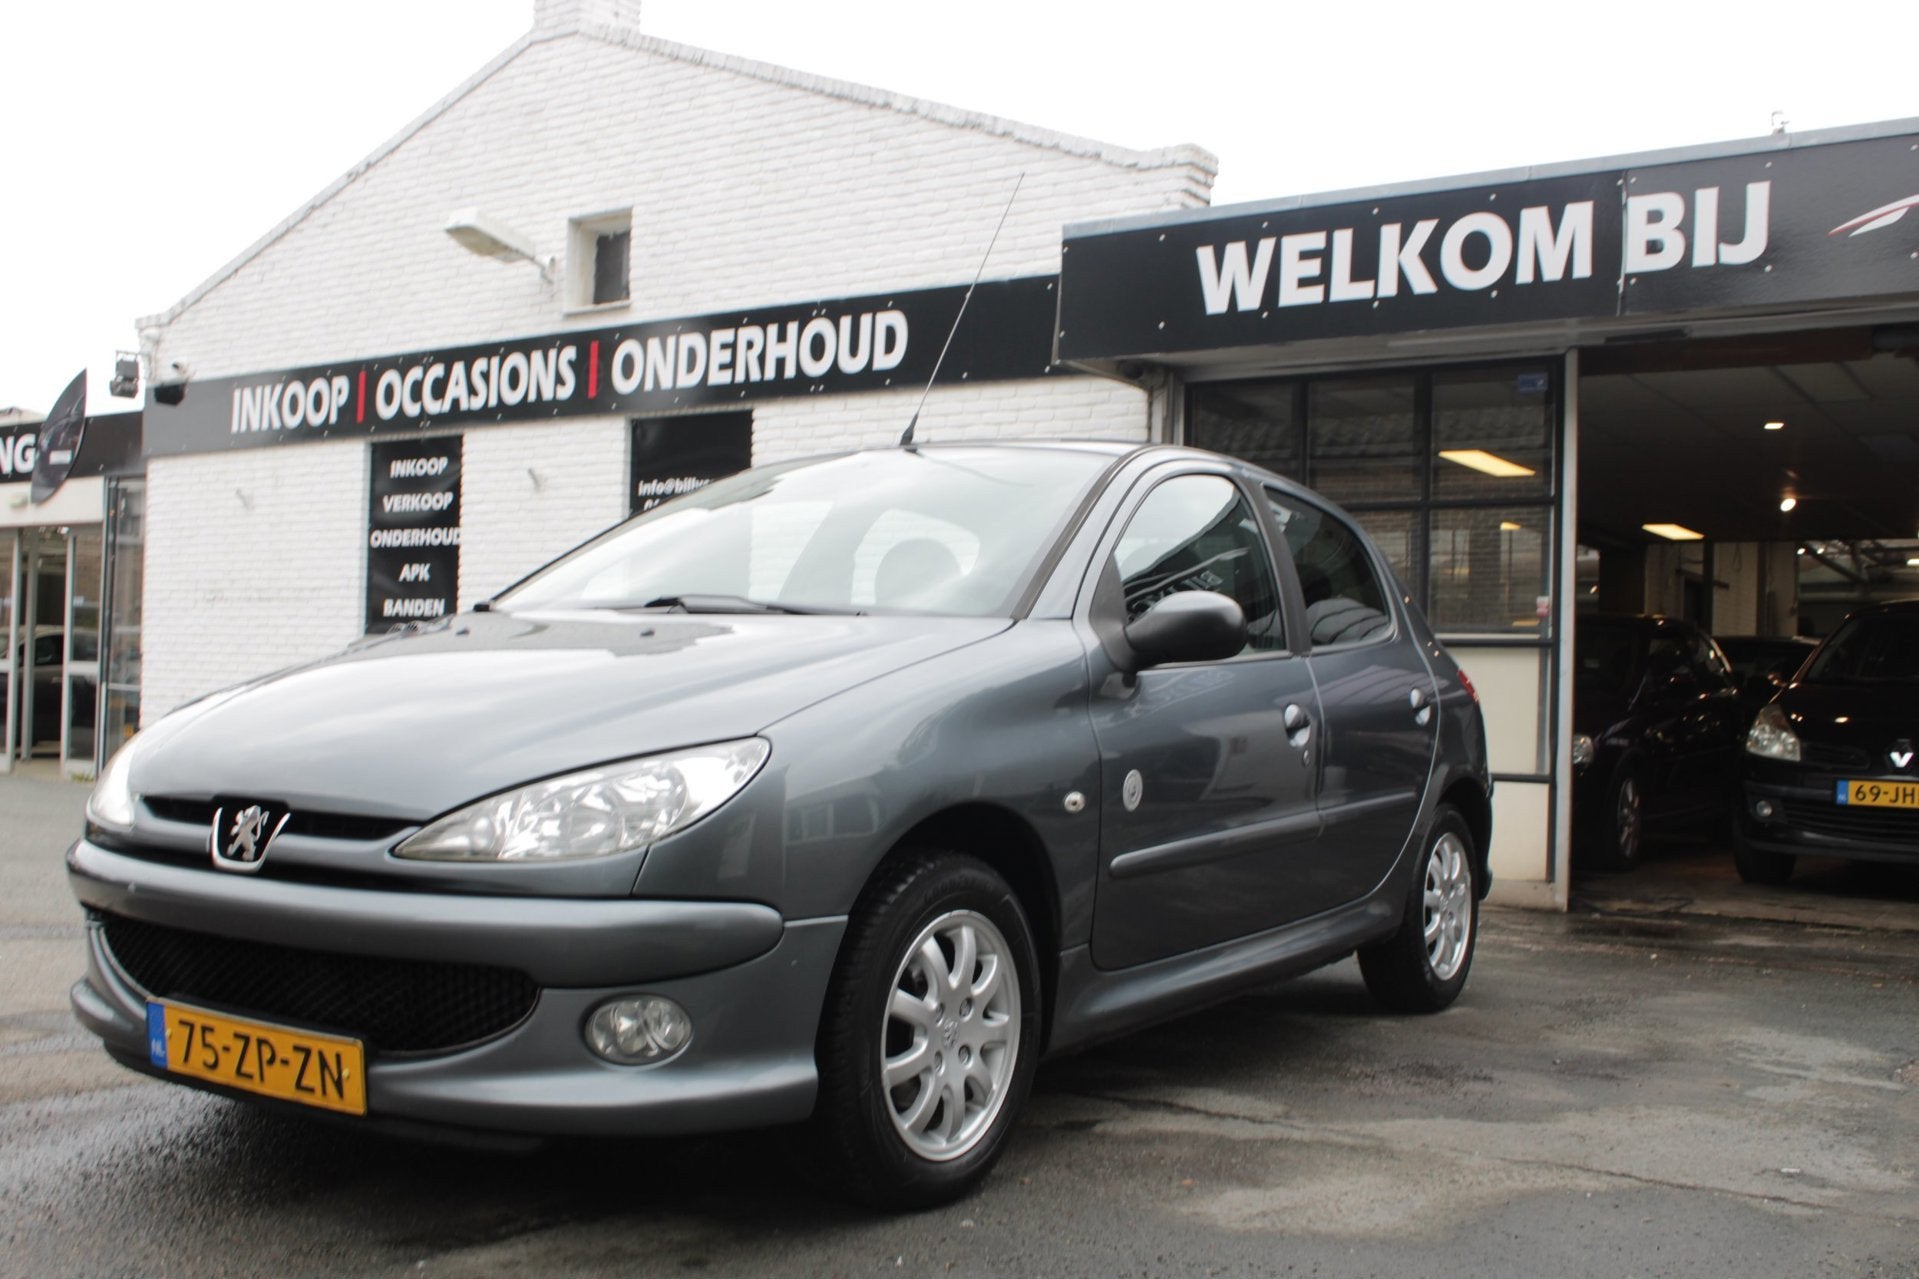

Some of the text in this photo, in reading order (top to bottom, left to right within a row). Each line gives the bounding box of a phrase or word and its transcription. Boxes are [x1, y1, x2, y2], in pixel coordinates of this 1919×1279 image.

[1196, 181, 1771, 315] WELKOM BIJ
[231, 310, 909, 433] INKOOP OCCASIONS ONDERHOUD
[390, 456, 448, 478] INKOOP
[382, 492, 454, 513] VERKOOP
[370, 527, 460, 548] ONDERHOUD
[399, 563, 431, 582] APK
[382, 598, 446, 617] BANDEN
[1855, 784, 1919, 804] 69-JH
[179, 1019, 345, 1099] 75-ZP-ZN
